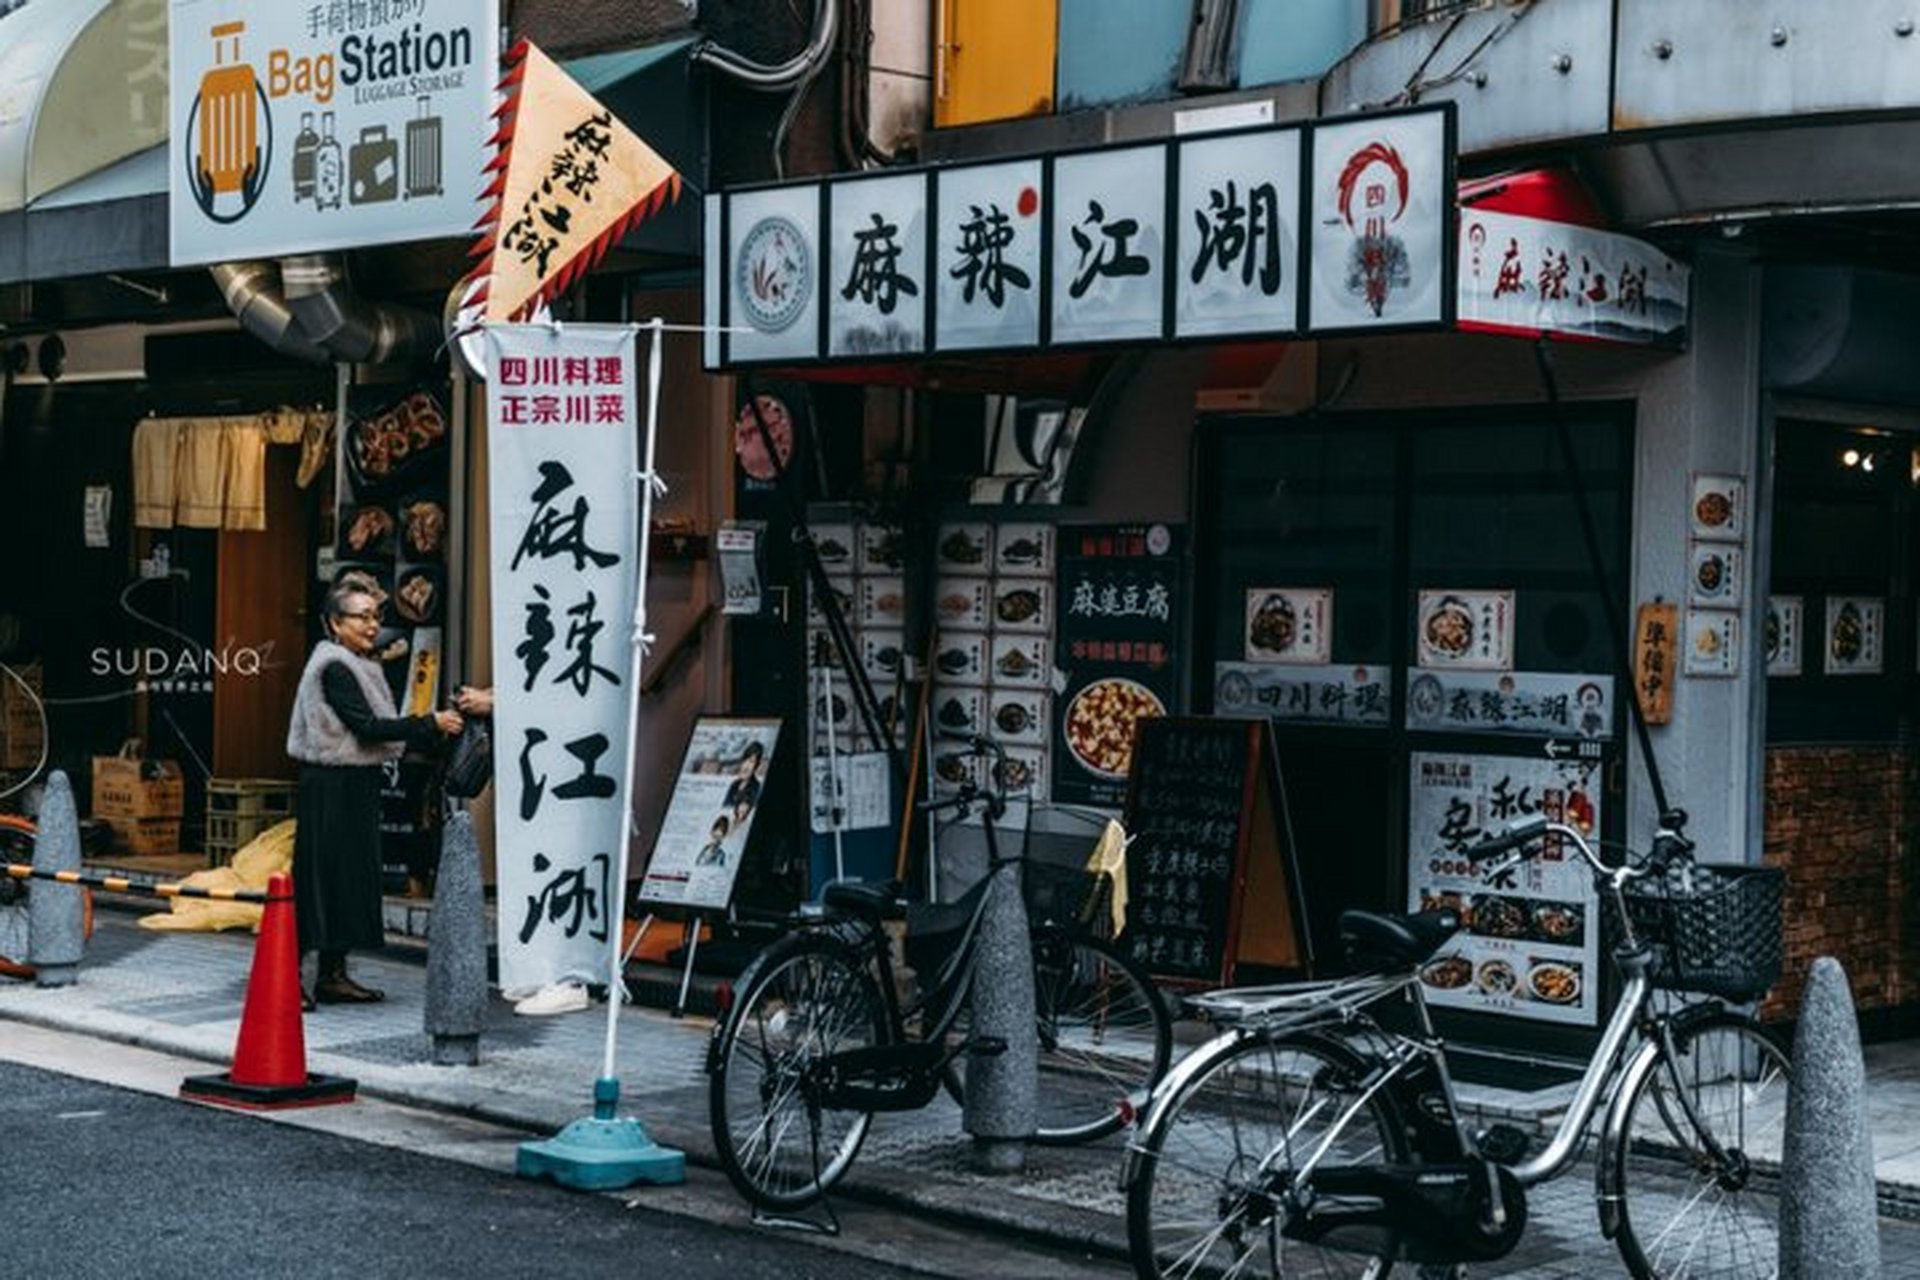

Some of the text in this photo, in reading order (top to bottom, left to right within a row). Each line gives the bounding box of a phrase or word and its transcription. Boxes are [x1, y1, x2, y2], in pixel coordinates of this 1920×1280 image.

[269, 23, 471, 103] Bag Station
[502, 112, 613, 279] 麻辣江湖
[841, 179, 1281, 317] 麻辣江湖
[1494, 237, 1648, 317] 麻辣江湖
[499, 356, 623, 386] 四川料理
[501, 394, 624, 425] 正宗川菜
[1068, 579, 1171, 623] 麻婆豆腐
[511, 460, 621, 944] 麻辣江湖
